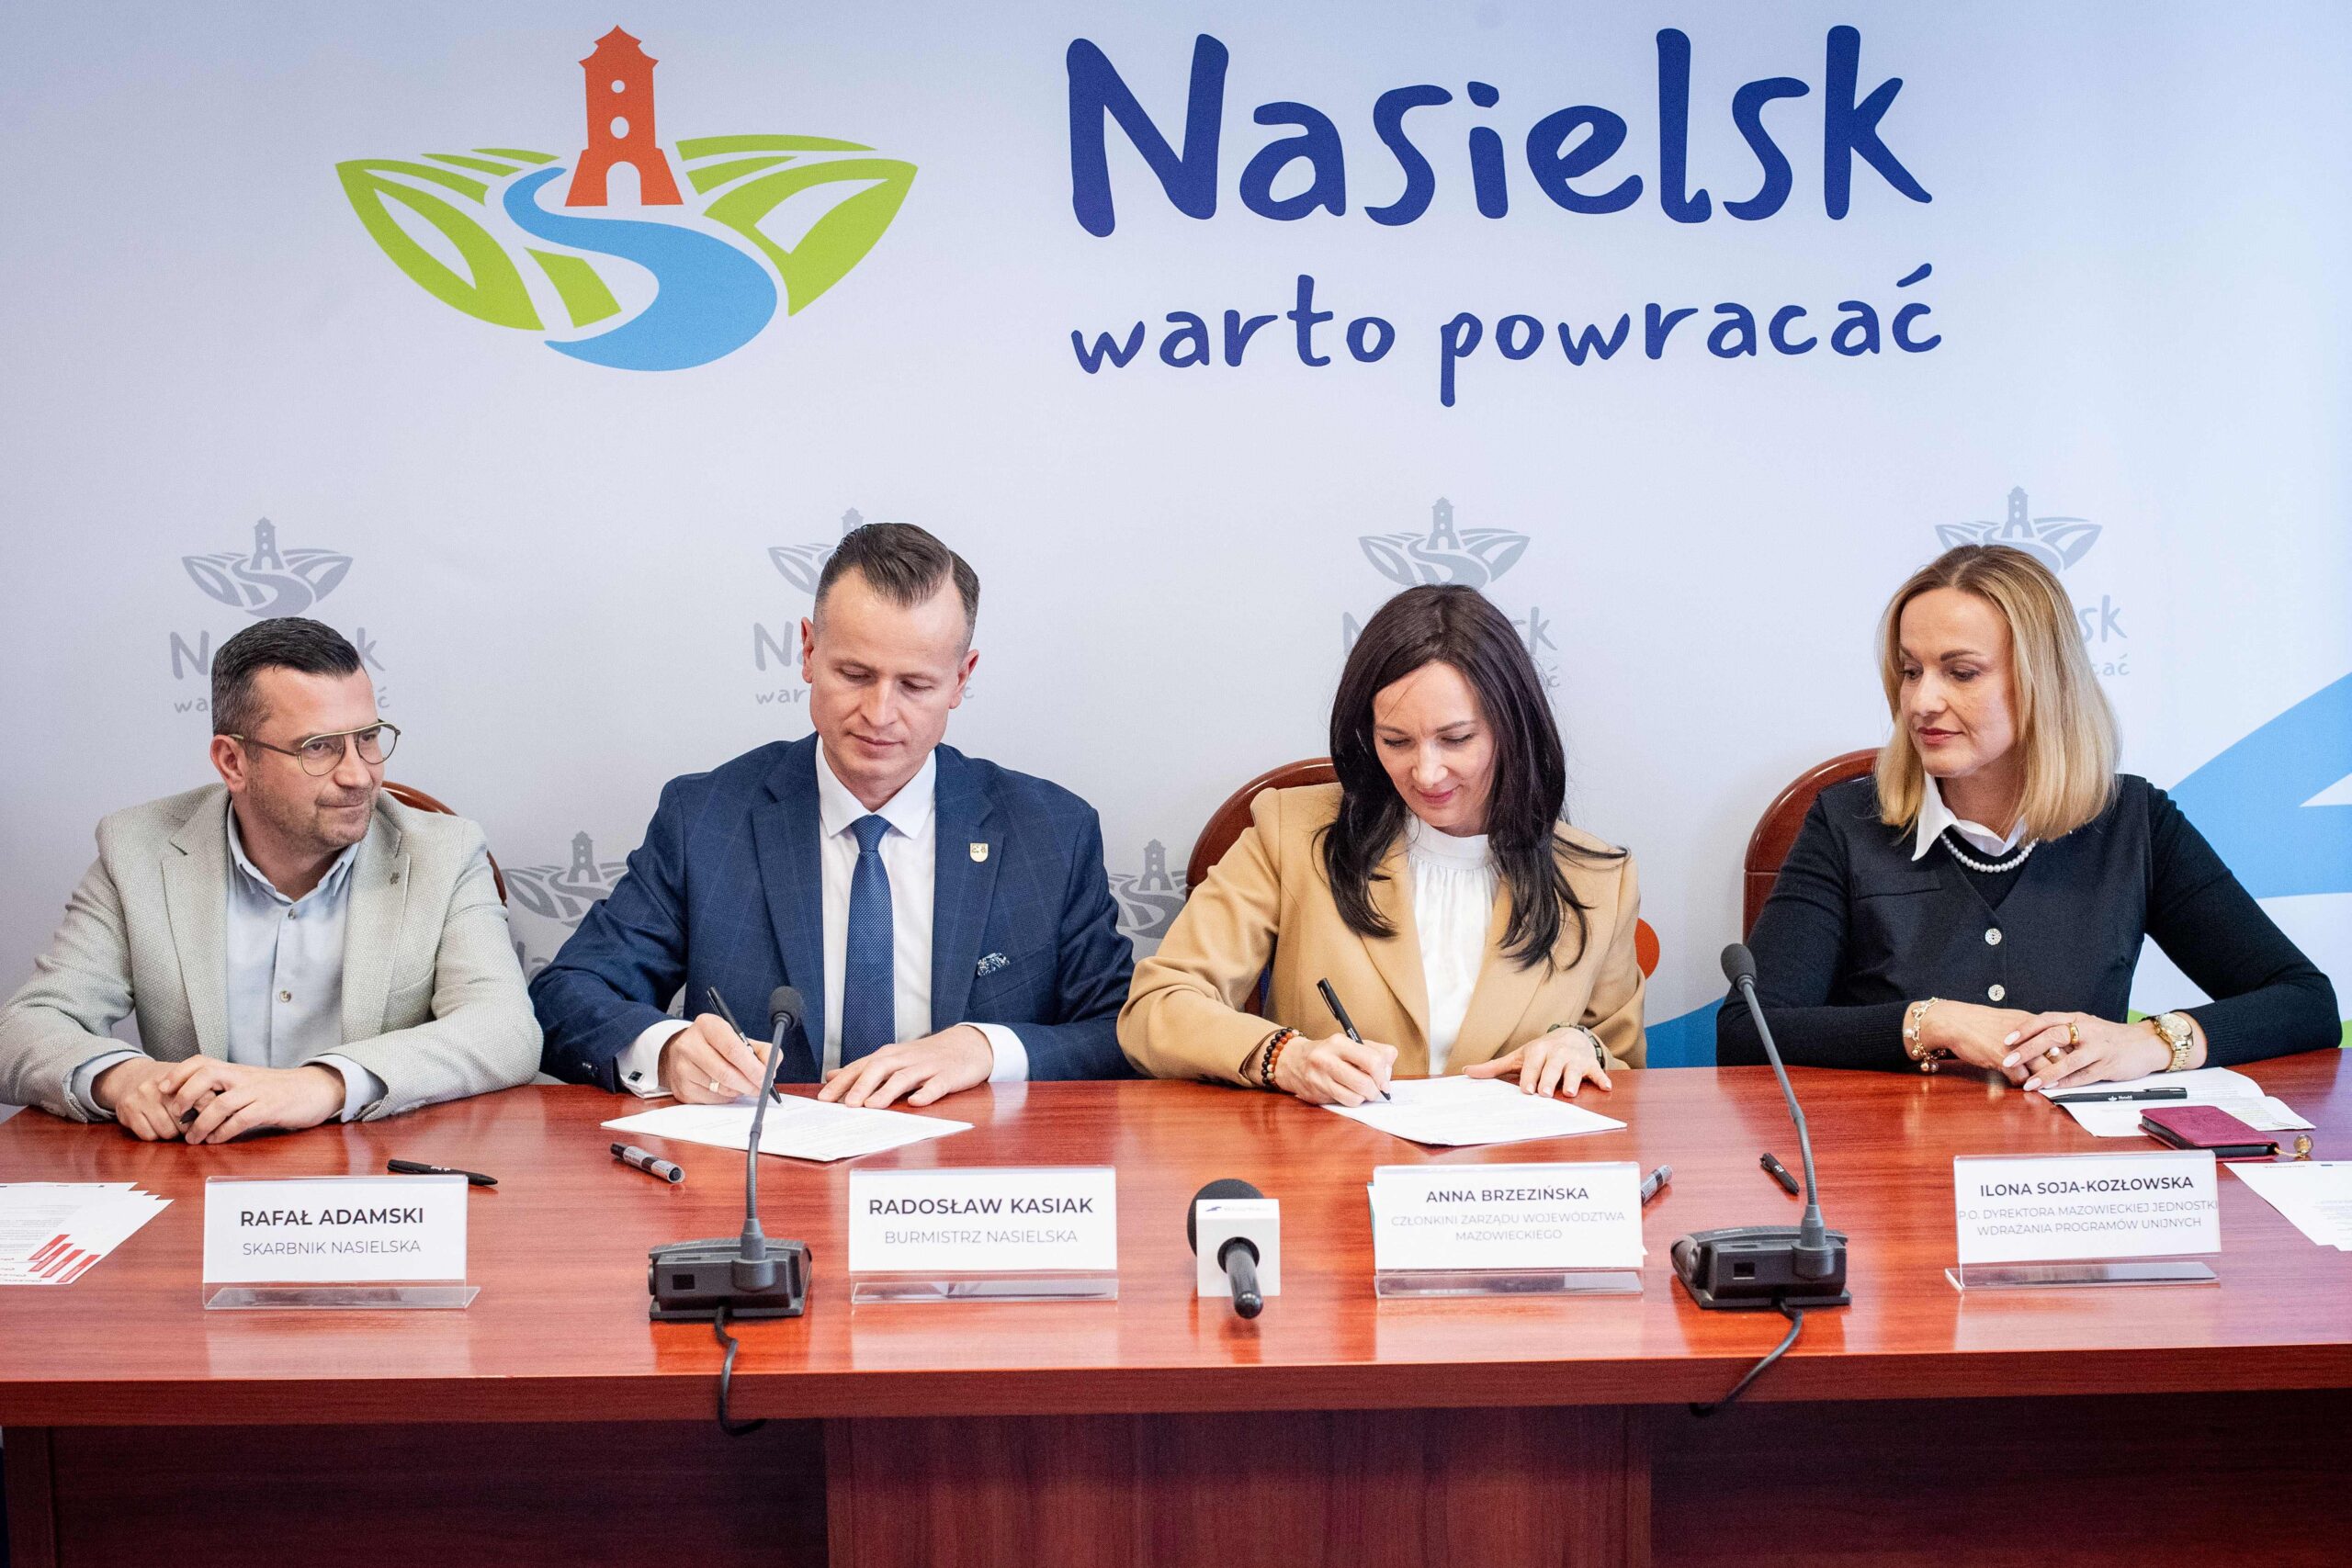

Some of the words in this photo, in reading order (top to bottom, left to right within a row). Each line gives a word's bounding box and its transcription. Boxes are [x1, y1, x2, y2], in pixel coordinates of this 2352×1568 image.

[1066, 25, 1933, 238] Nasielsk
[1070, 274, 1396, 375] warto
[1440, 263, 1942, 408] powracać
[1426, 1190, 1476, 1202] ANNA
[1481, 1185, 1589, 1202] BRZEZIŃSKA
[1980, 1182, 2032, 1197] ILONA
[2037, 1176, 2194, 1194] SOJA-KOZŁOWSKA
[869, 1198, 1003, 1214] RADOSŁAW
[1011, 1198, 1093, 1213] KASIAK
[1983, 1206, 2055, 1220] DYREKTORA
[2058, 1201, 2149, 1216] MAZOWIECKIEJ
[2151, 1200, 2218, 1213] JEDNOSTKI
[240, 1210, 313, 1226] RAFAŁ
[319, 1207, 424, 1225] ADAMSKI
[1391, 1215, 1458, 1227] CZŁONKINI
[1461, 1213, 1520, 1227] ZARZĄDU
[1522, 1210, 1625, 1224] WOJEWÓDZTWA
[2055, 1217, 2139, 1233] PROGRAMÓW
[2142, 1217, 2201, 1229] UNIJNYCH
[885, 1230, 981, 1244] BURMISTRZ
[987, 1229, 1078, 1243] NASIELSKA
[1455, 1229, 1564, 1241] MAZOWIECKIEGO
[243, 1241, 326, 1256] SKARBNIK
[331, 1239, 421, 1254] NASIELSKA
